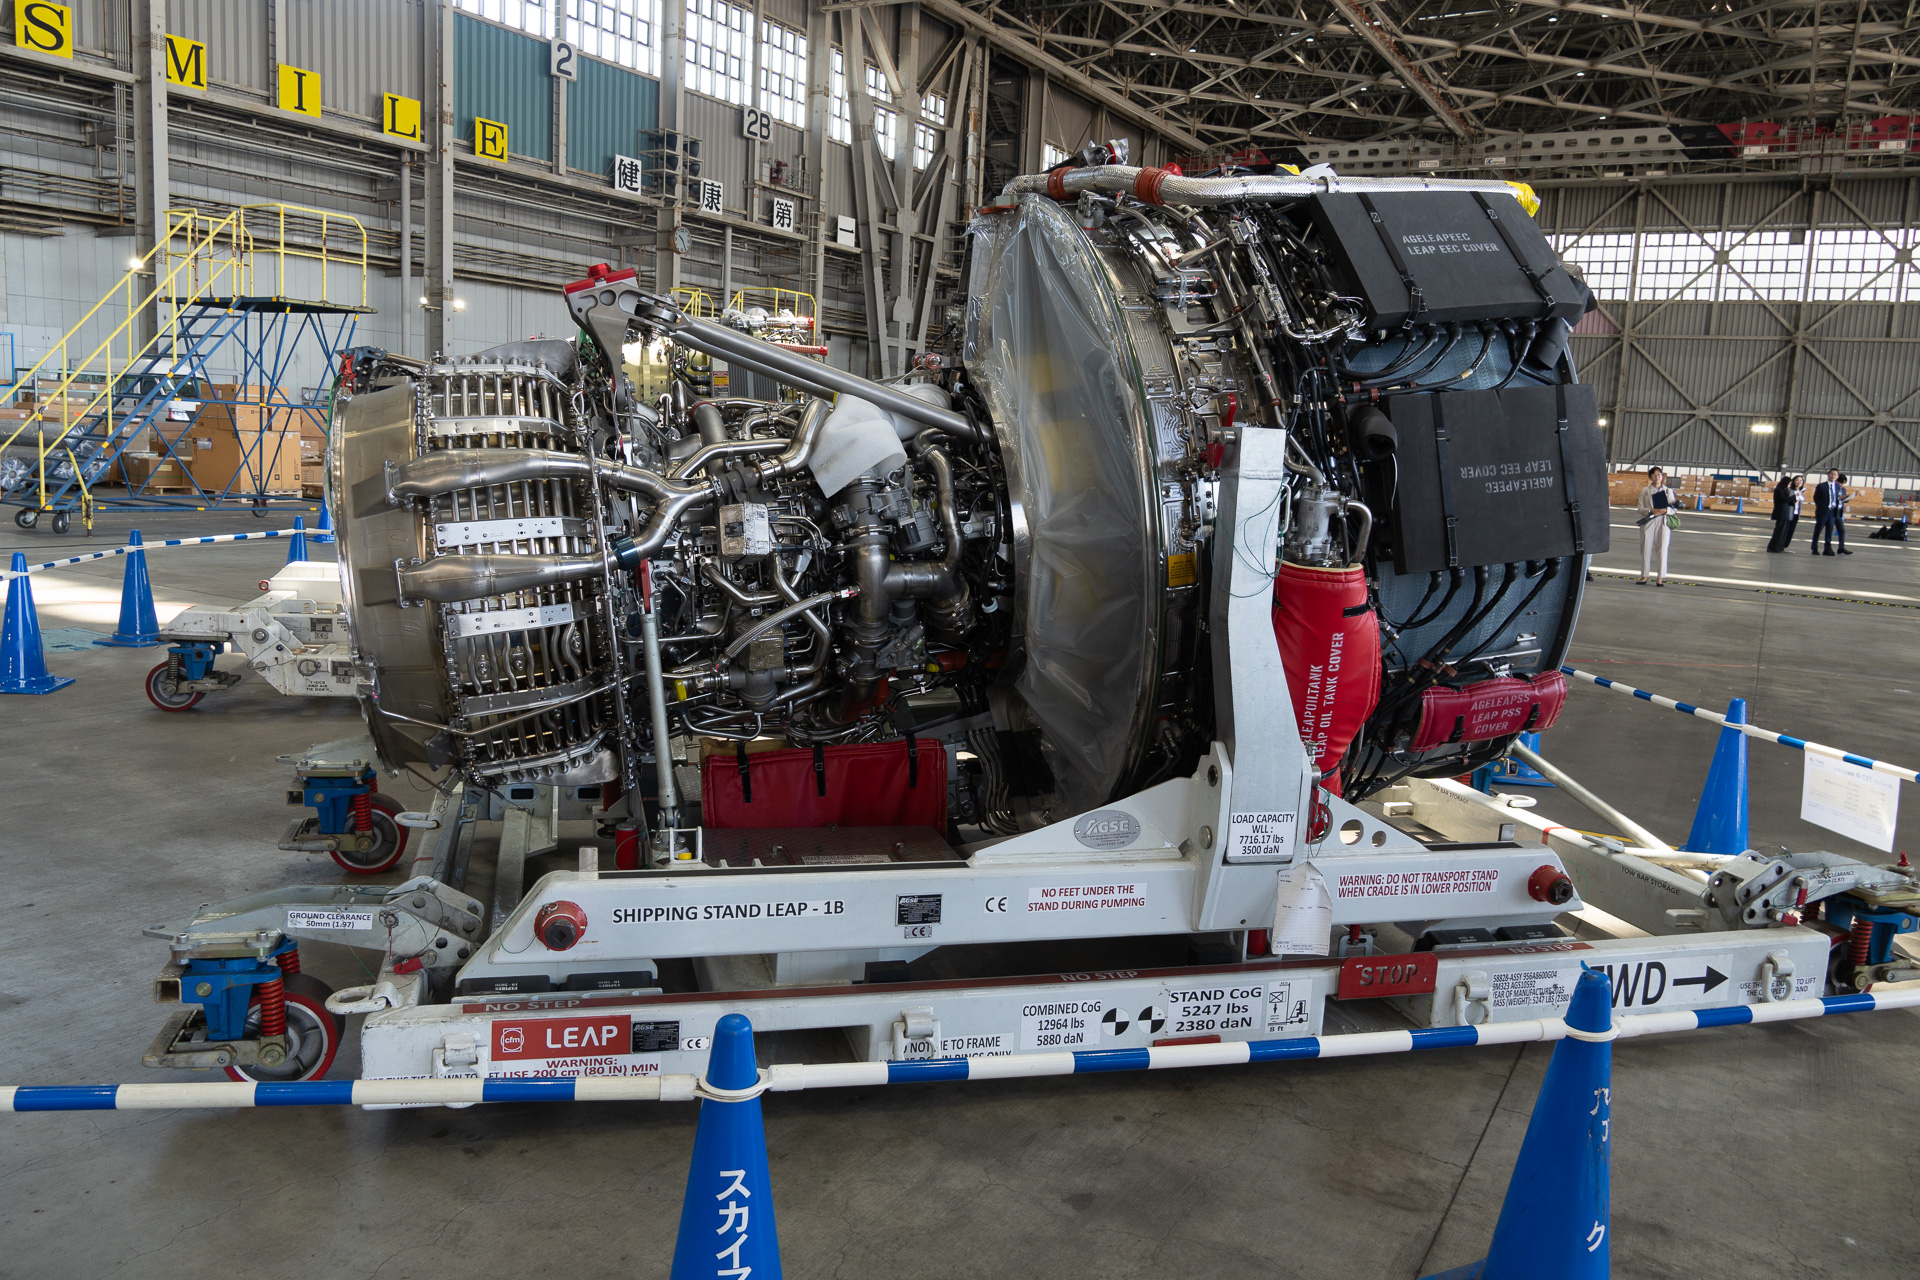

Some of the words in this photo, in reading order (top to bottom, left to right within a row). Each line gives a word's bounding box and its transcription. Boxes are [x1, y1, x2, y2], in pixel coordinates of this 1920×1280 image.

[556, 43, 572, 76] 2
[747, 109, 770, 140] 2B
[617, 159, 640, 192] 健
[703, 181, 722, 213] 康
[775, 200, 793, 228] 第
[1402, 233, 1470, 244] AGELEAPEEC
[1407, 245, 1436, 255] LEAP
[1439, 244, 1460, 254] EEC
[1462, 243, 1499, 253] COVER
[1460, 464, 1497, 479] COVER
[1501, 462, 1521, 476] EEC
[1524, 460, 1552, 473] LEAP
[1485, 477, 1554, 494] AGELEAPEEC
[1328, 632, 1344, 672] COVER
[1323, 676, 1338, 707] TANK
[1471, 693, 1530, 711] AGELEAPSS
[1320, 711, 1333, 728] OIL
[1472, 711, 1499, 724] LEAP
[1501, 707, 1522, 718] PSS
[1474, 721, 1509, 734] COVER
[1315, 731, 1329, 759] LEAP
[1232, 814, 1255, 824] LOAD
[1256, 813, 1295, 823] CAPACITY
[1252, 825, 1269, 834] WLL
[1239, 835, 1271, 844] 7716.17
[1272, 834, 1284, 844] lbs
[1242, 845, 1262, 855] 3500
[1263, 845, 1280, 854] daN
[1339, 874, 1385, 887] WARNING:
[1386, 873, 1400, 884] DO
[1401, 873, 1420, 884] NOT
[1421, 871, 1471, 883] TRANSPORT
[1471, 870, 1499, 881] STAND
[1621, 866, 1636, 877] TOW
[1636, 872, 1649, 883] BAR
[1650, 878, 1680, 896] STORAGE
[1041, 888, 1057, 898] NO
[1059, 887, 1081, 897] FEET
[1082, 885, 1115, 896] UNDER
[1117, 884, 1135, 894] THE
[1338, 886, 1365, 898] WHEN
[1366, 885, 1399, 897] CRADLE
[1401, 884, 1409, 895] IS
[1410, 884, 1420, 895] IN
[1421, 883, 1451, 894] LOWER
[1452, 881, 1492, 893] POSITION
[612, 906, 698, 923] SHIPPING
[703, 904, 761, 919] STAND
[766, 902, 808, 917] LEAP
[823, 900, 844, 915] 1B
[985, 896, 1007, 913] CE
[1028, 901, 1059, 912] STAND
[1061, 899, 1099, 910] DURING
[1100, 897, 1146, 908] PUMPING
[289, 912, 325, 920] GROUND
[326, 913, 372, 921] CLEARANCE
[332, 921, 355, 929] (1.97)
[911, 926, 926, 937] CE
[1508, 946, 1536, 954] NO
[1537, 943, 1574, 952] STEP
[1060, 973, 1091, 982] NO
[1094, 970, 1138, 980] STEP
[1360, 964, 1418, 987] STOP
[1169, 989, 1225, 1003] STAND
[1229, 987, 1263, 1000] CoG
[1505, 989, 1513, 998] OF
[1532, 996, 1544, 1005] 5247
[1545, 995, 1555, 1003] LBS
[485, 1003, 520, 1012] NO
[527, 1000, 580, 1010] STEP
[1023, 1002, 1081, 1017] COMBINED
[1081, 1001, 1101, 1014] CoG
[1182, 1004, 1221, 1017] 5247
[1226, 1002, 1249, 1015] lbs
[1038, 1019, 1069, 1031] 12964
[1070, 1018, 1085, 1029] lbs
[1175, 1019, 1215, 1032] 2380
[1220, 1016, 1252, 1029] daN
[504, 1036, 521, 1044] cfm
[546, 1025, 619, 1049] LEAP
[687, 1038, 702, 1049] CE
[1037, 1034, 1061, 1046] 5880
[1063, 1032, 1084, 1045] daN
[910, 1042, 930, 1054] NOT
[950, 1039, 964, 1050] TO
[966, 1036, 1001, 1049] FRAME
[532, 1069, 557, 1078] 200
[584, 1066, 605, 1077] (80
[607, 1064, 628, 1075] IN)
[631, 1063, 659, 1073] MIN
[546, 1057, 618, 1069] WARNING:
